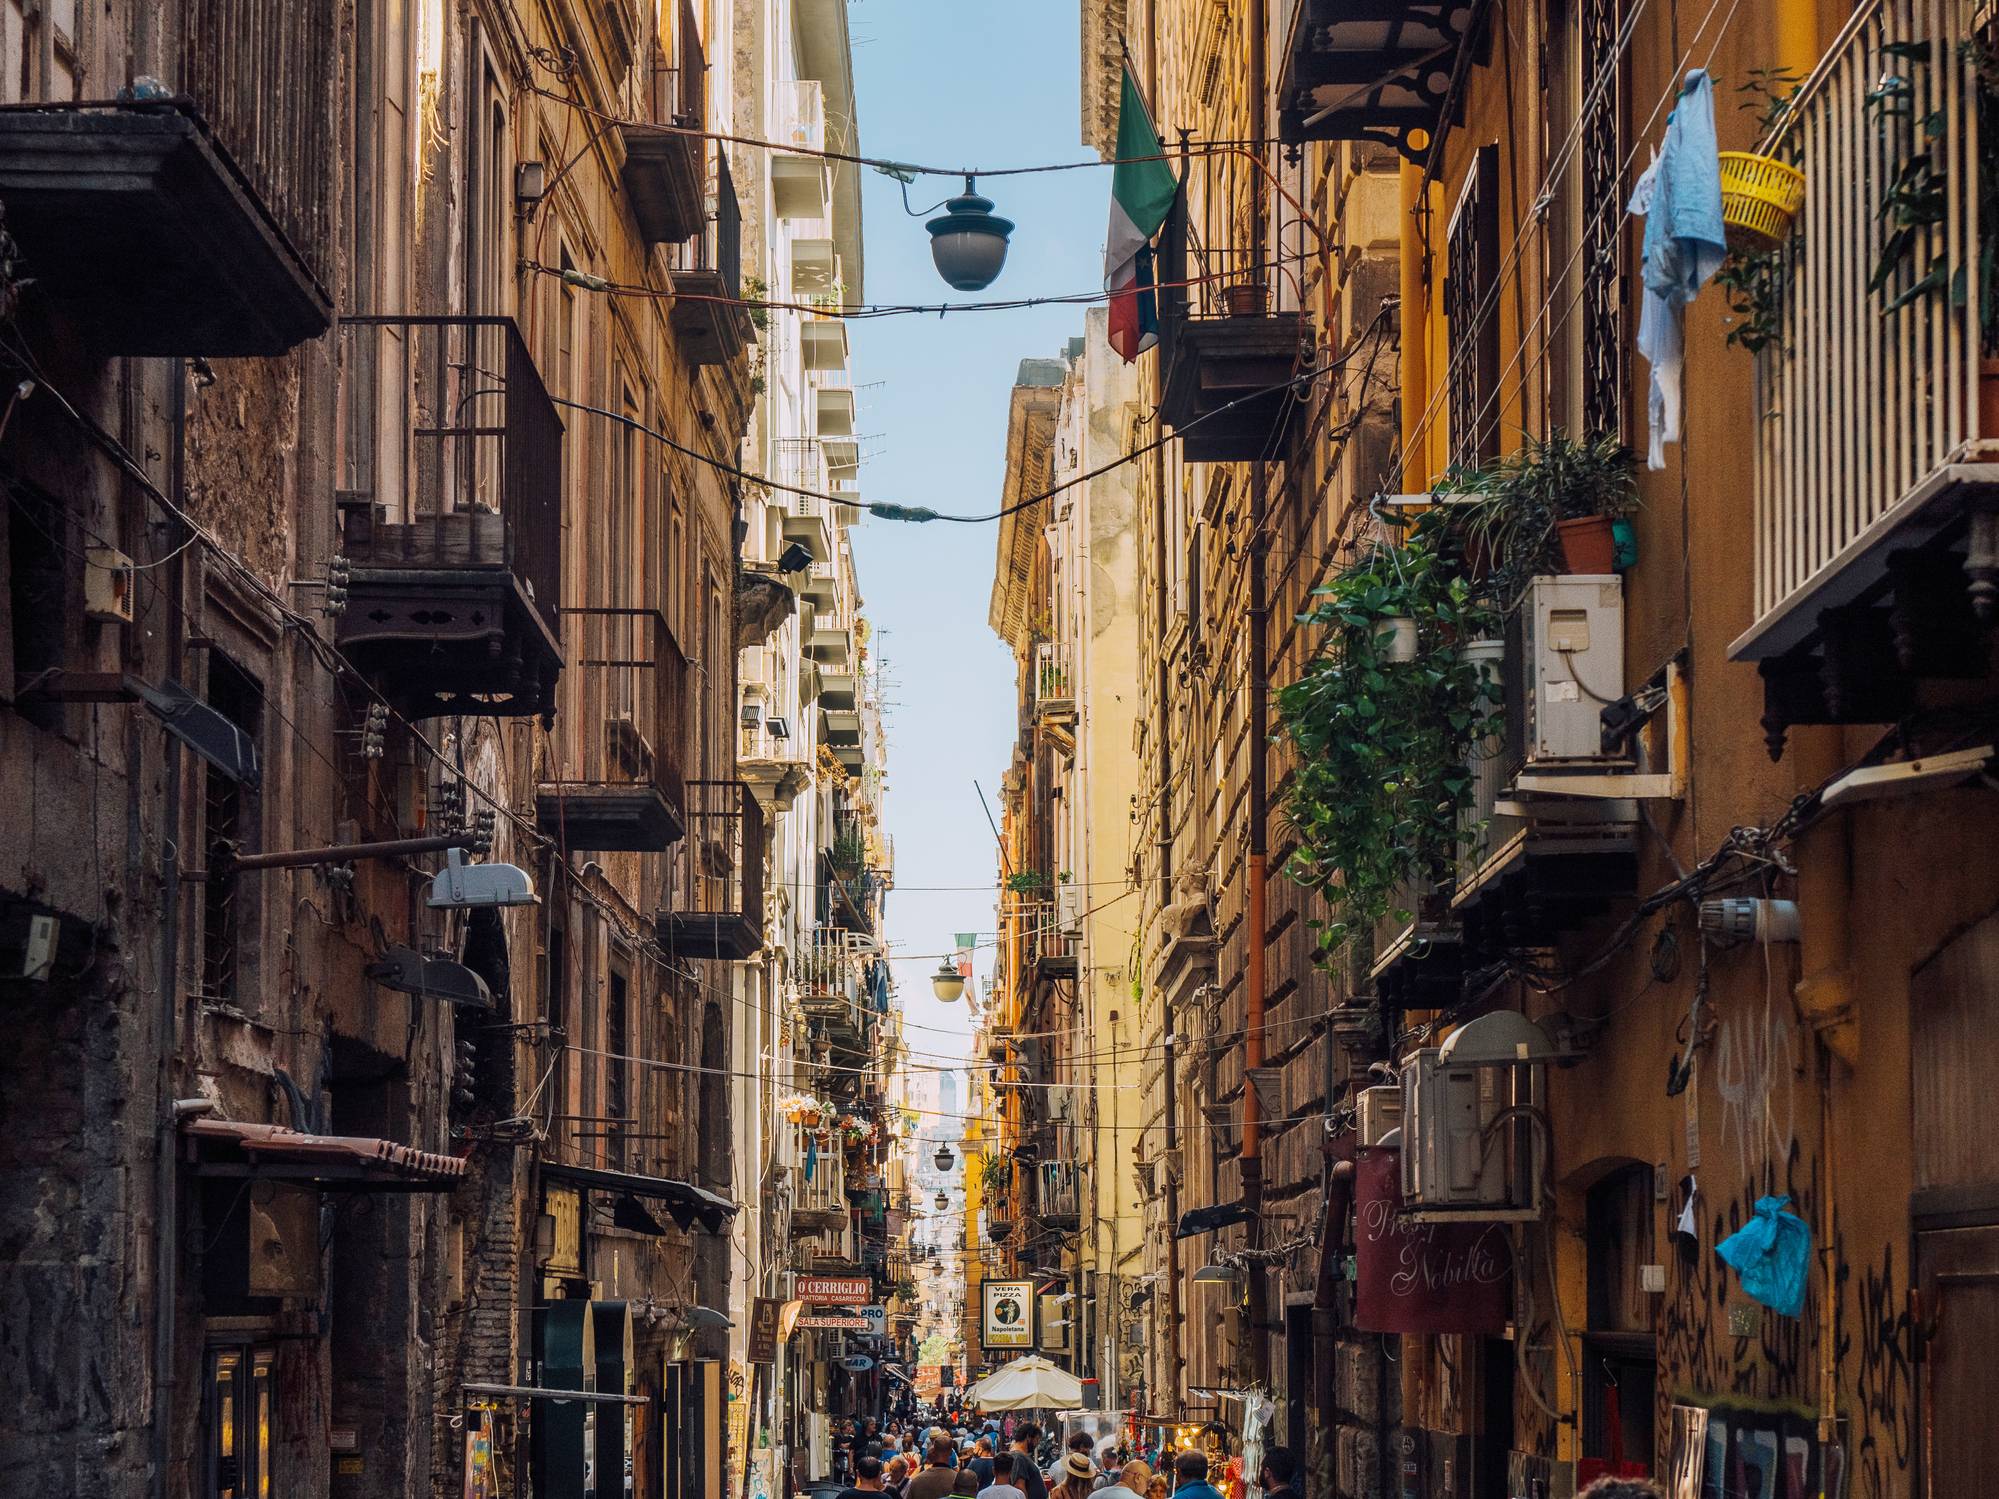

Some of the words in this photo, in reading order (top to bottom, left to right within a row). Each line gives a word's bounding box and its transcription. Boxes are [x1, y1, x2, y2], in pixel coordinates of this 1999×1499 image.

[808, 1281, 866, 1295] CERRIGLIO
[861, 1309, 883, 1319] PRO
[798, 1318, 819, 1327] SALA
[820, 1318, 866, 1327] SUPERIORE
[845, 1359, 867, 1368] BAR
